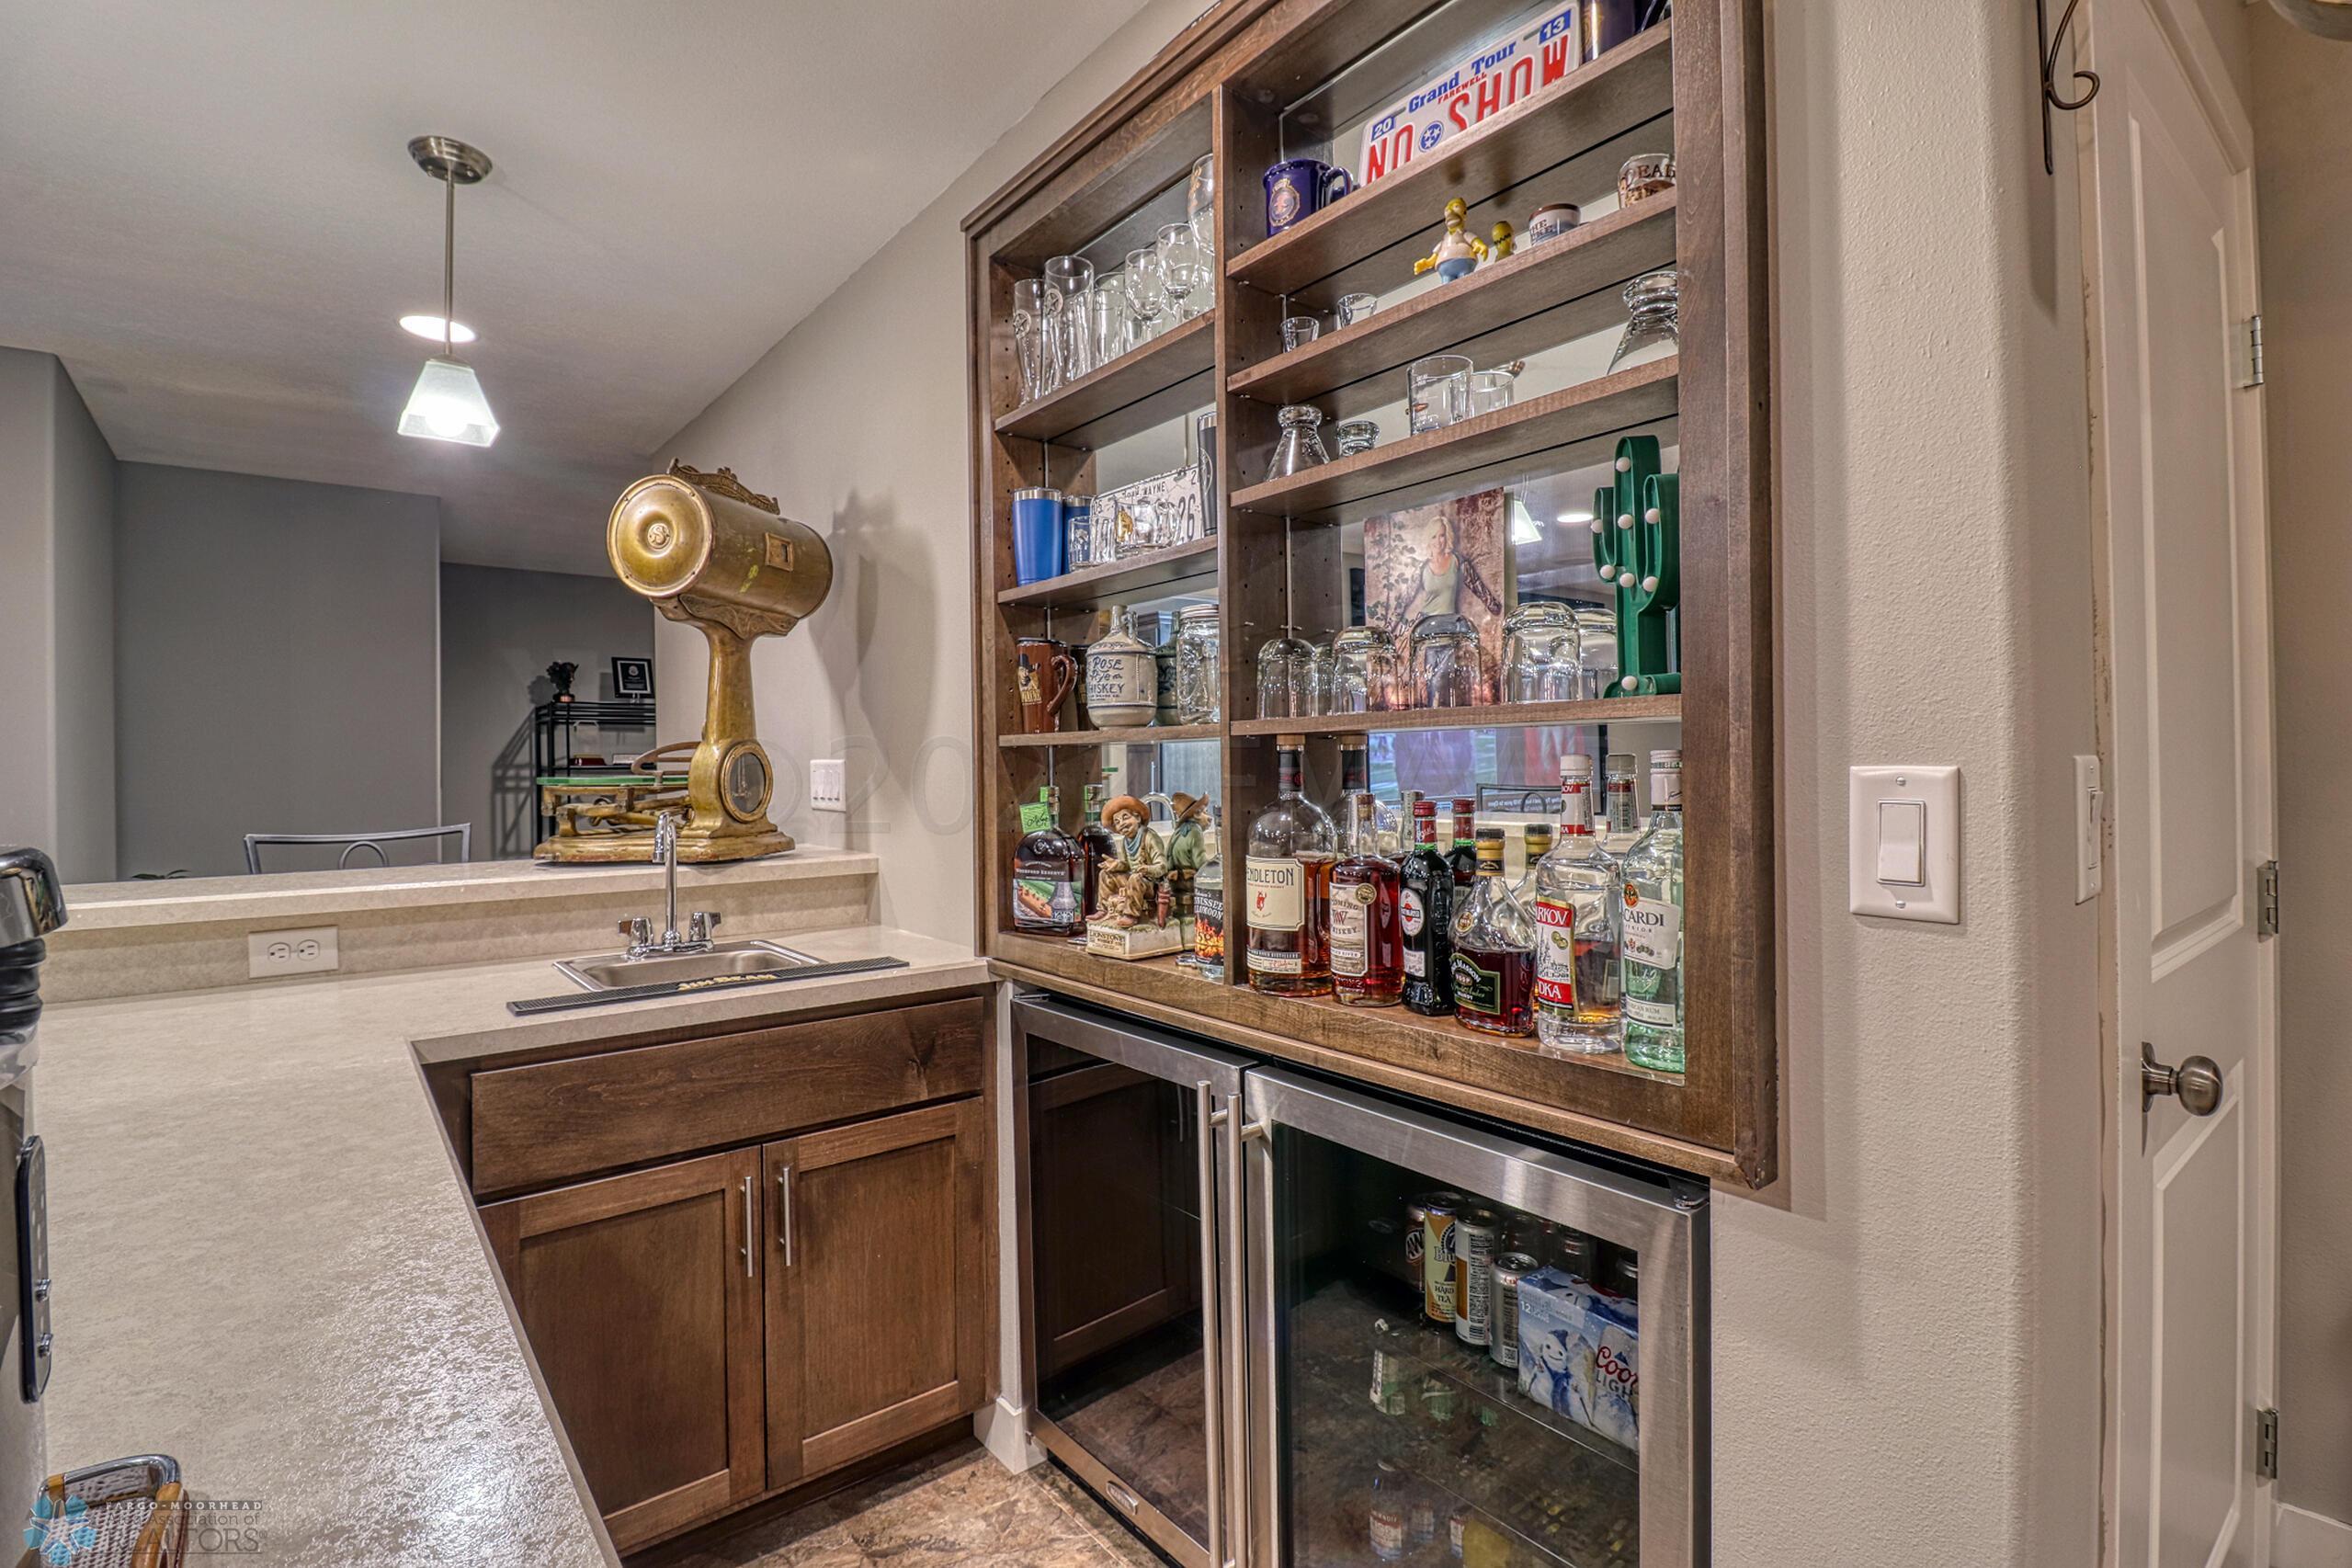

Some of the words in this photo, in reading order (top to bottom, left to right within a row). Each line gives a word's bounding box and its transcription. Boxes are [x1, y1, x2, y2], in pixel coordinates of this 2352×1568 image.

[1542, 16, 1565, 39] 13
[1408, 72, 1460, 113] Grand
[1471, 41, 1517, 74] Tour
[1437, 72, 1487, 105] FAREWELL
[1367, 123, 1414, 185] NO
[1449, 34, 1569, 132] SHOW
[1374, 119, 1393, 138] 20
[1246, 867, 1294, 886] ENDLETON
[1536, 906, 1568, 925] RKOV
[1624, 908, 1665, 926] CARDI
[1538, 981, 1562, 999] DKA
[1520, 1301, 1531, 1313] 12
[1596, 1346, 1639, 1389] Coor
[1596, 1369, 1634, 1398] LIGH
